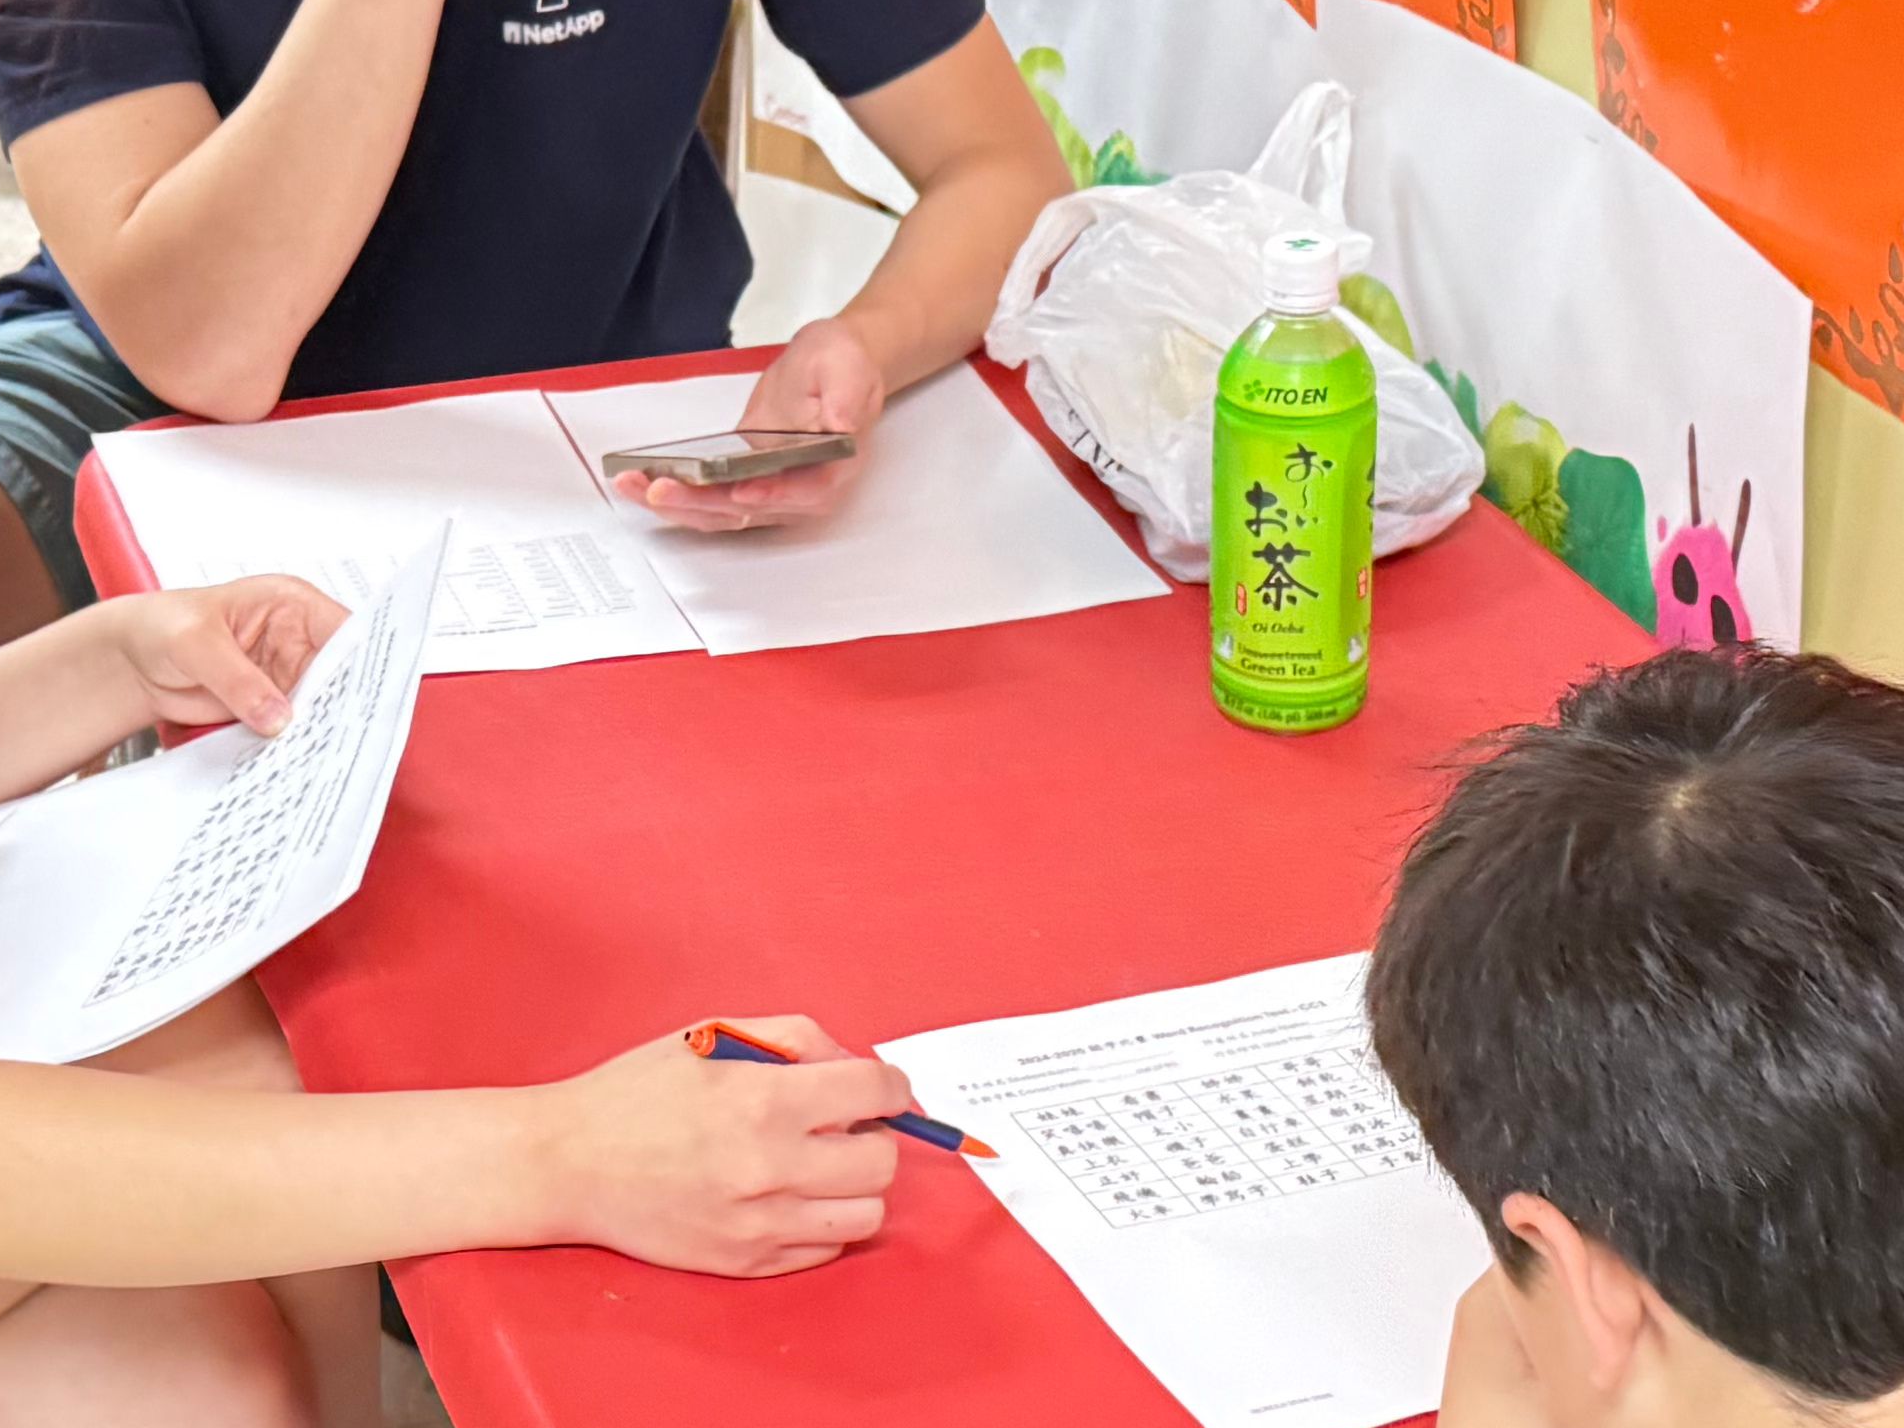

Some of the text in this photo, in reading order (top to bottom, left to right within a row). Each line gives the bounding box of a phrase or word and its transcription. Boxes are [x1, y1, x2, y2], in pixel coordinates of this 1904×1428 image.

[523, 9, 605, 45] NetApp
[1264, 386, 1329, 405] ITO EN
[1244, 480, 1319, 612] お茶
[1241, 657, 1316, 677] Green Tea
[1220, 1089, 1256, 1103] 水果
